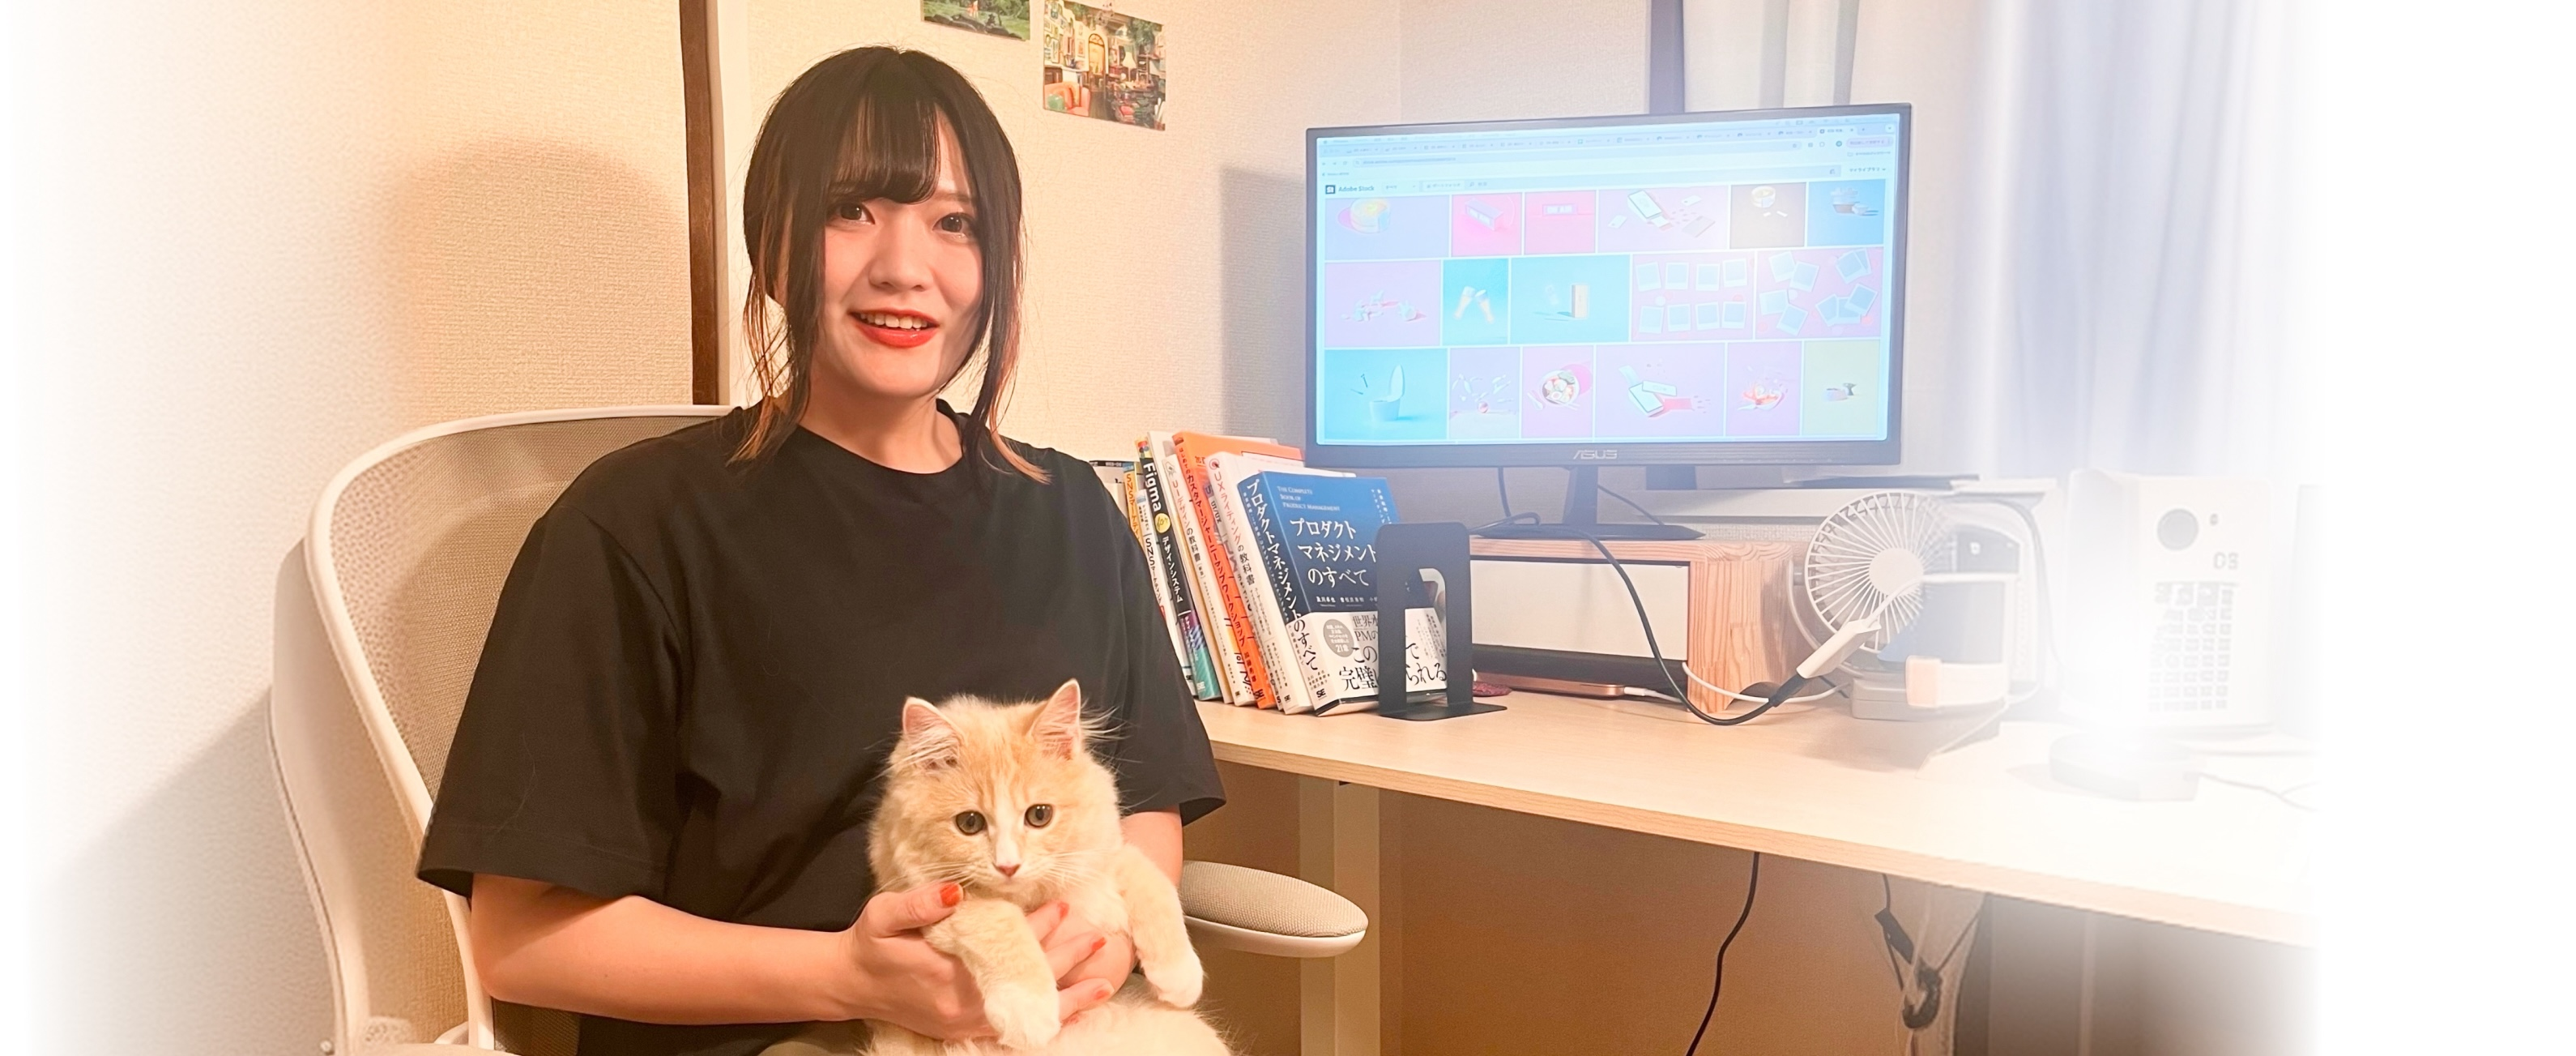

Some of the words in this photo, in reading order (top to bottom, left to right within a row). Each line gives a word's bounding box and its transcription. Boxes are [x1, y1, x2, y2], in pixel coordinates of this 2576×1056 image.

[1572, 449, 1618, 460] ASUS
[1143, 463, 1162, 512] Figma
[1290, 517, 1356, 539] プロダクト
[1298, 542, 1376, 562] マネジメント
[1162, 536, 1184, 603] デザインシステム
[1247, 479, 1318, 670] プロダクトマネジメントのすべて
[1307, 566, 1369, 588] のすべて
[1316, 688, 1327, 699] SE
